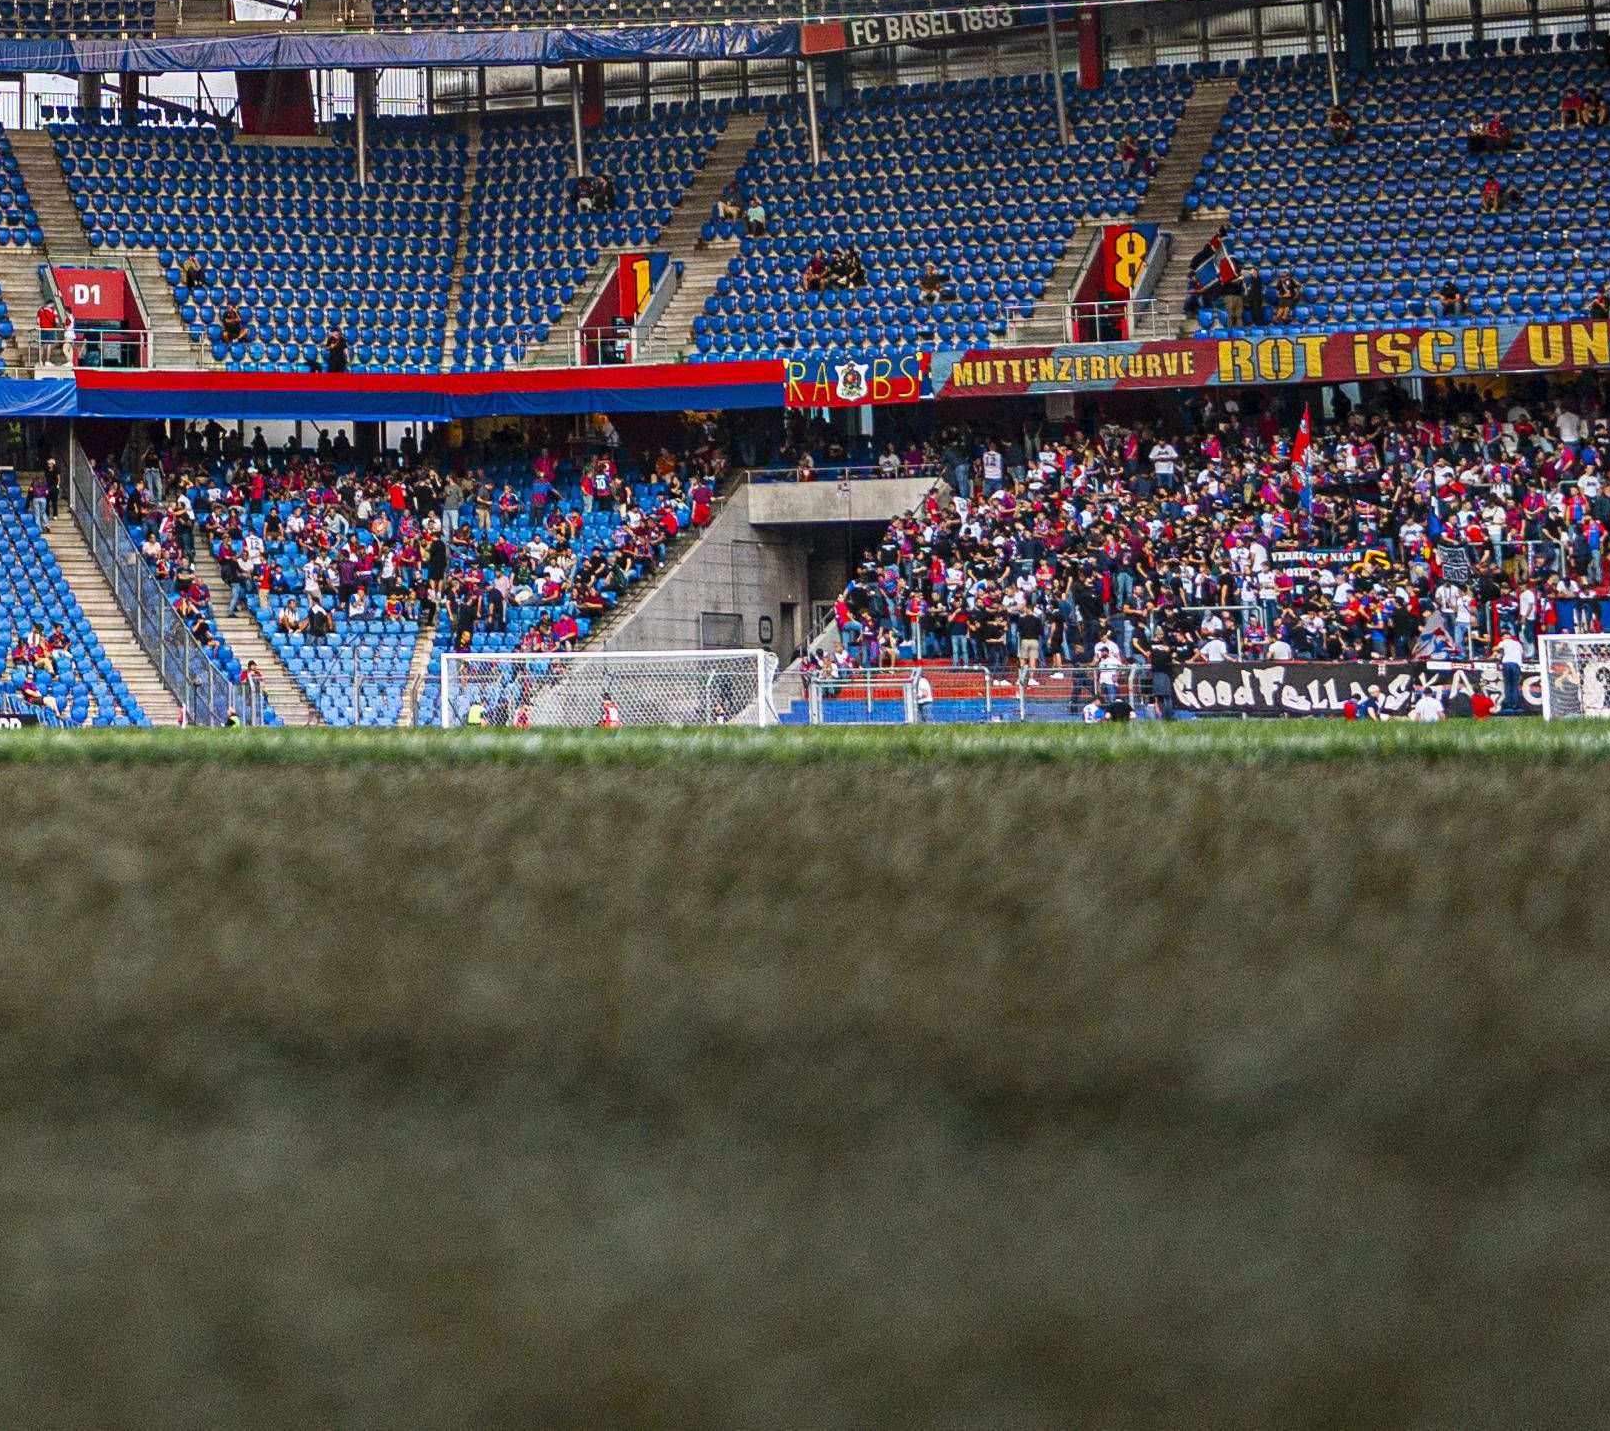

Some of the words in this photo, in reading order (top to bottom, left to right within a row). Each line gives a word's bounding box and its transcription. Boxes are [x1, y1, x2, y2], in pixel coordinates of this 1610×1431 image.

[851, 18, 880, 47] FC
[884, 10, 956, 42] BASEL
[958, 1, 1014, 33] 1893
[631, 259, 651, 314] 1
[1114, 231, 1147, 289] 8
[74, 282, 101, 306] D1
[951, 350, 1195, 388] MUTTENZERKURVE
[1217, 333, 1328, 384] ROT
